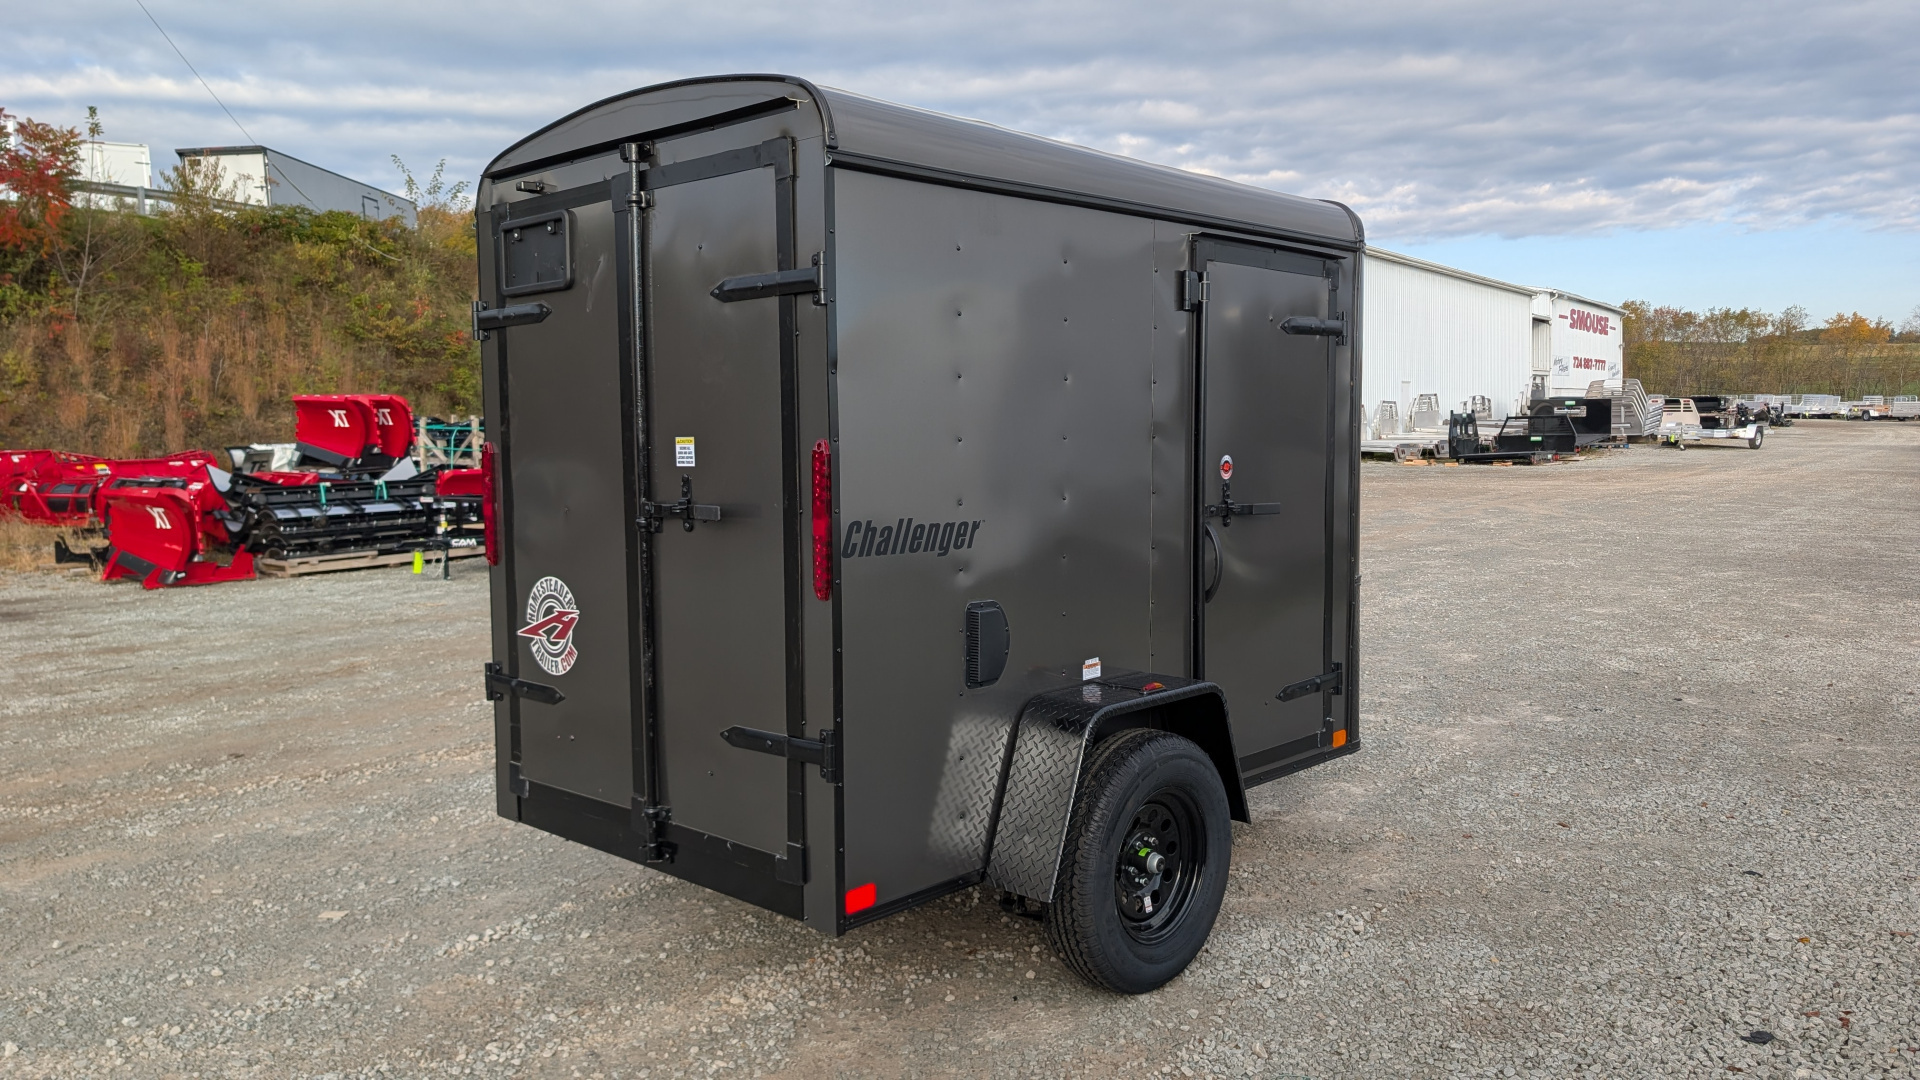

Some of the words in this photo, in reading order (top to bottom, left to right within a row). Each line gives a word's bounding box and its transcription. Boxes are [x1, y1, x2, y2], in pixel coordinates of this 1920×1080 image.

[1569, 308, 1609, 335] SMOUSE
[451, 538, 478, 547] CAM
[841, 517, 982, 559] Challenger
[527, 578, 575, 622] HOMESTEADER
